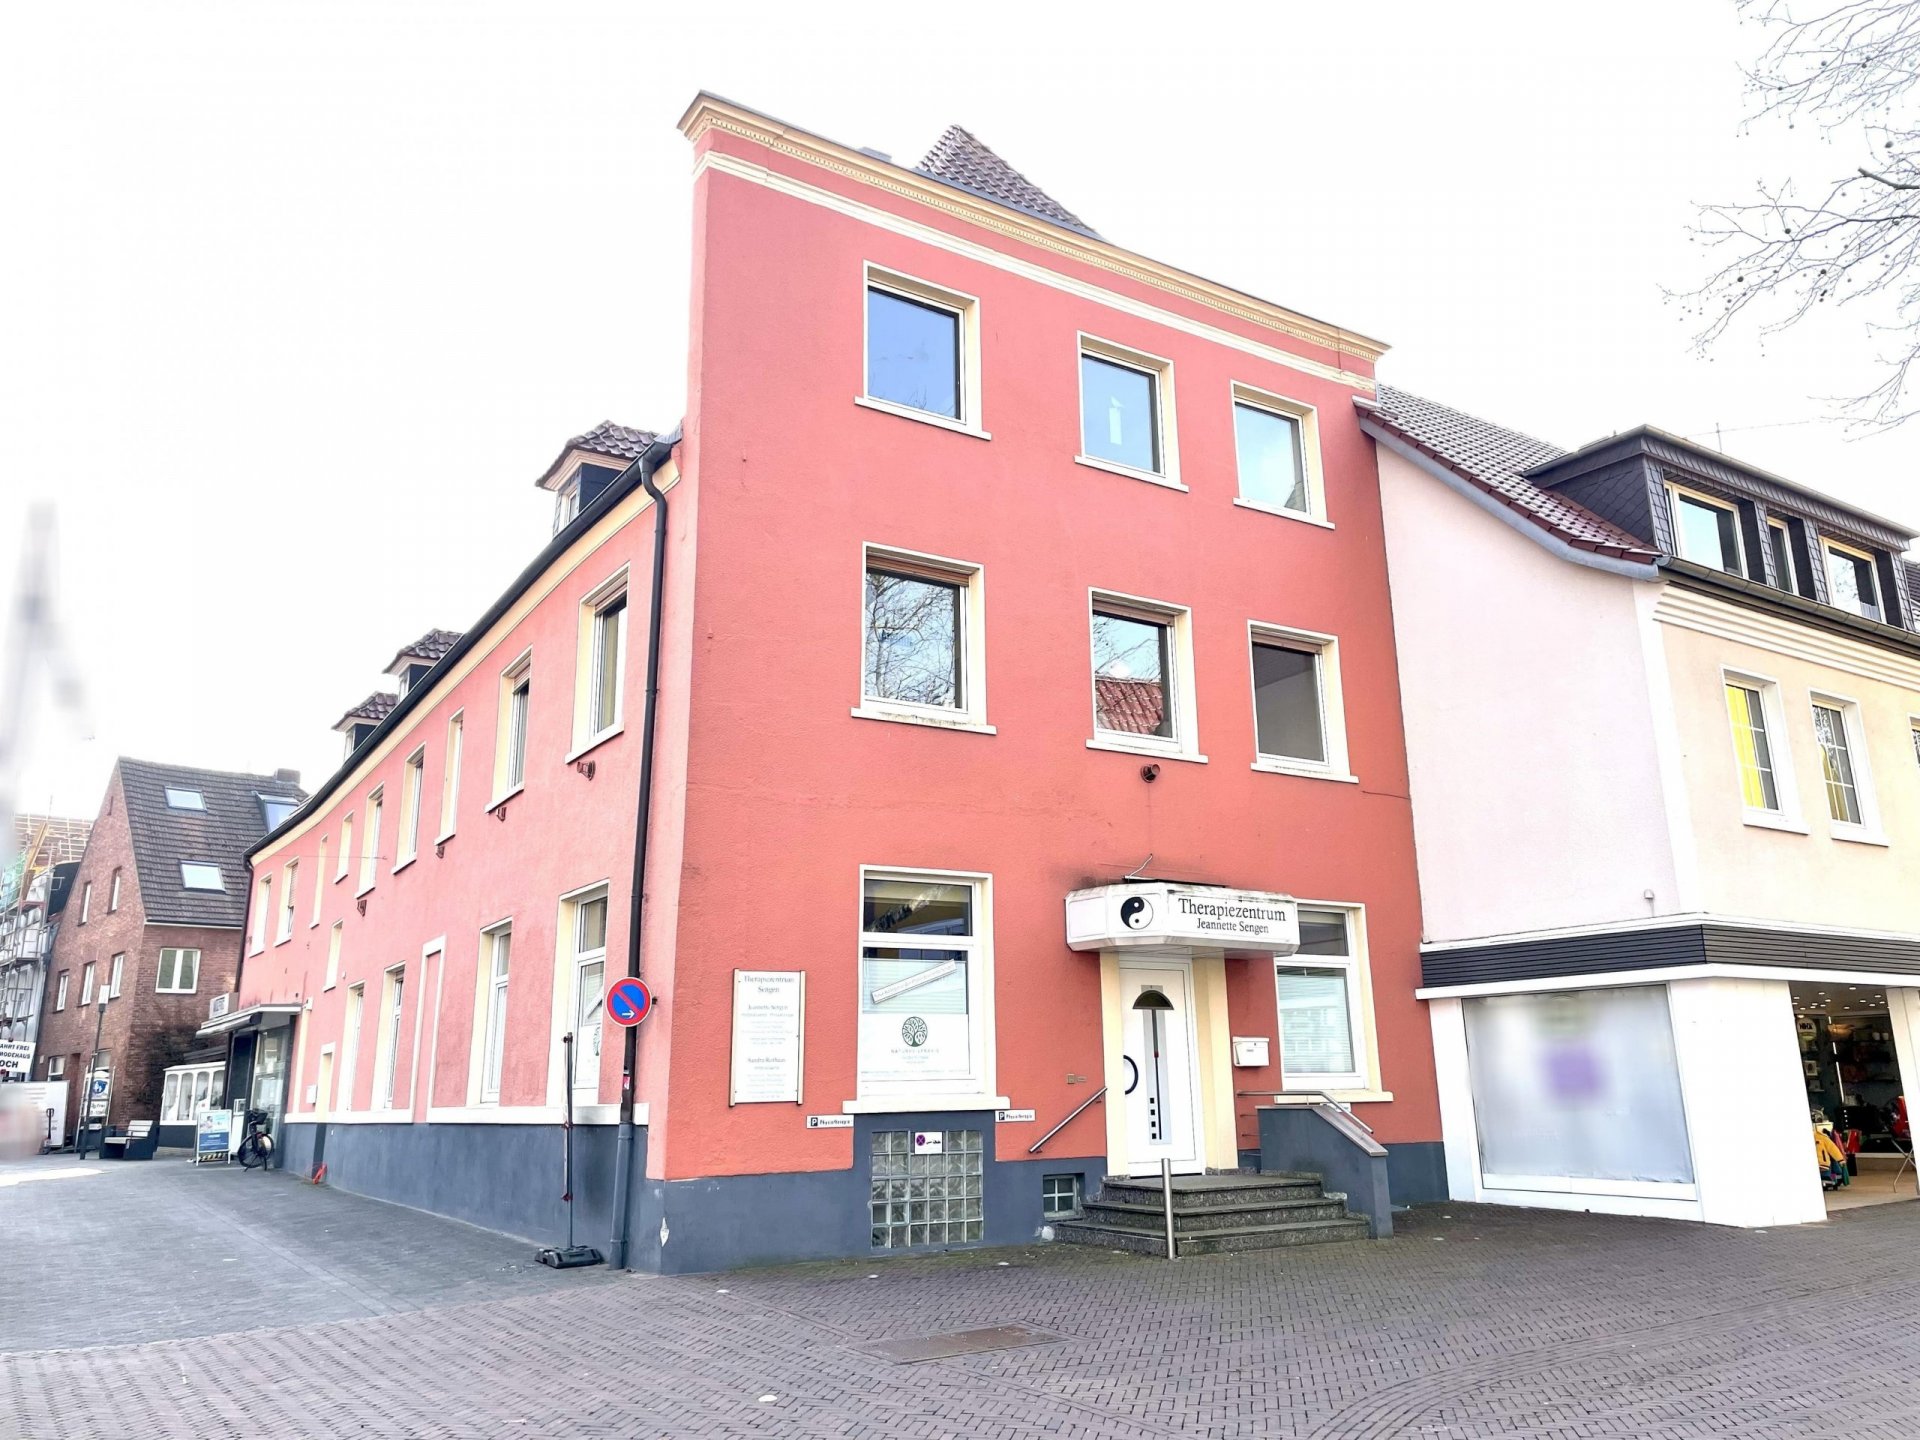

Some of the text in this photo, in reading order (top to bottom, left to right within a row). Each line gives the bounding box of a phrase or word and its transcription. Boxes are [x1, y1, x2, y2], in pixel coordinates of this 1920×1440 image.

[1178, 897, 1286, 922] Therapiezentrum
[1196, 917, 1269, 935] Jeannette Sengen
[744, 975, 795, 985] Therapiezentrum
